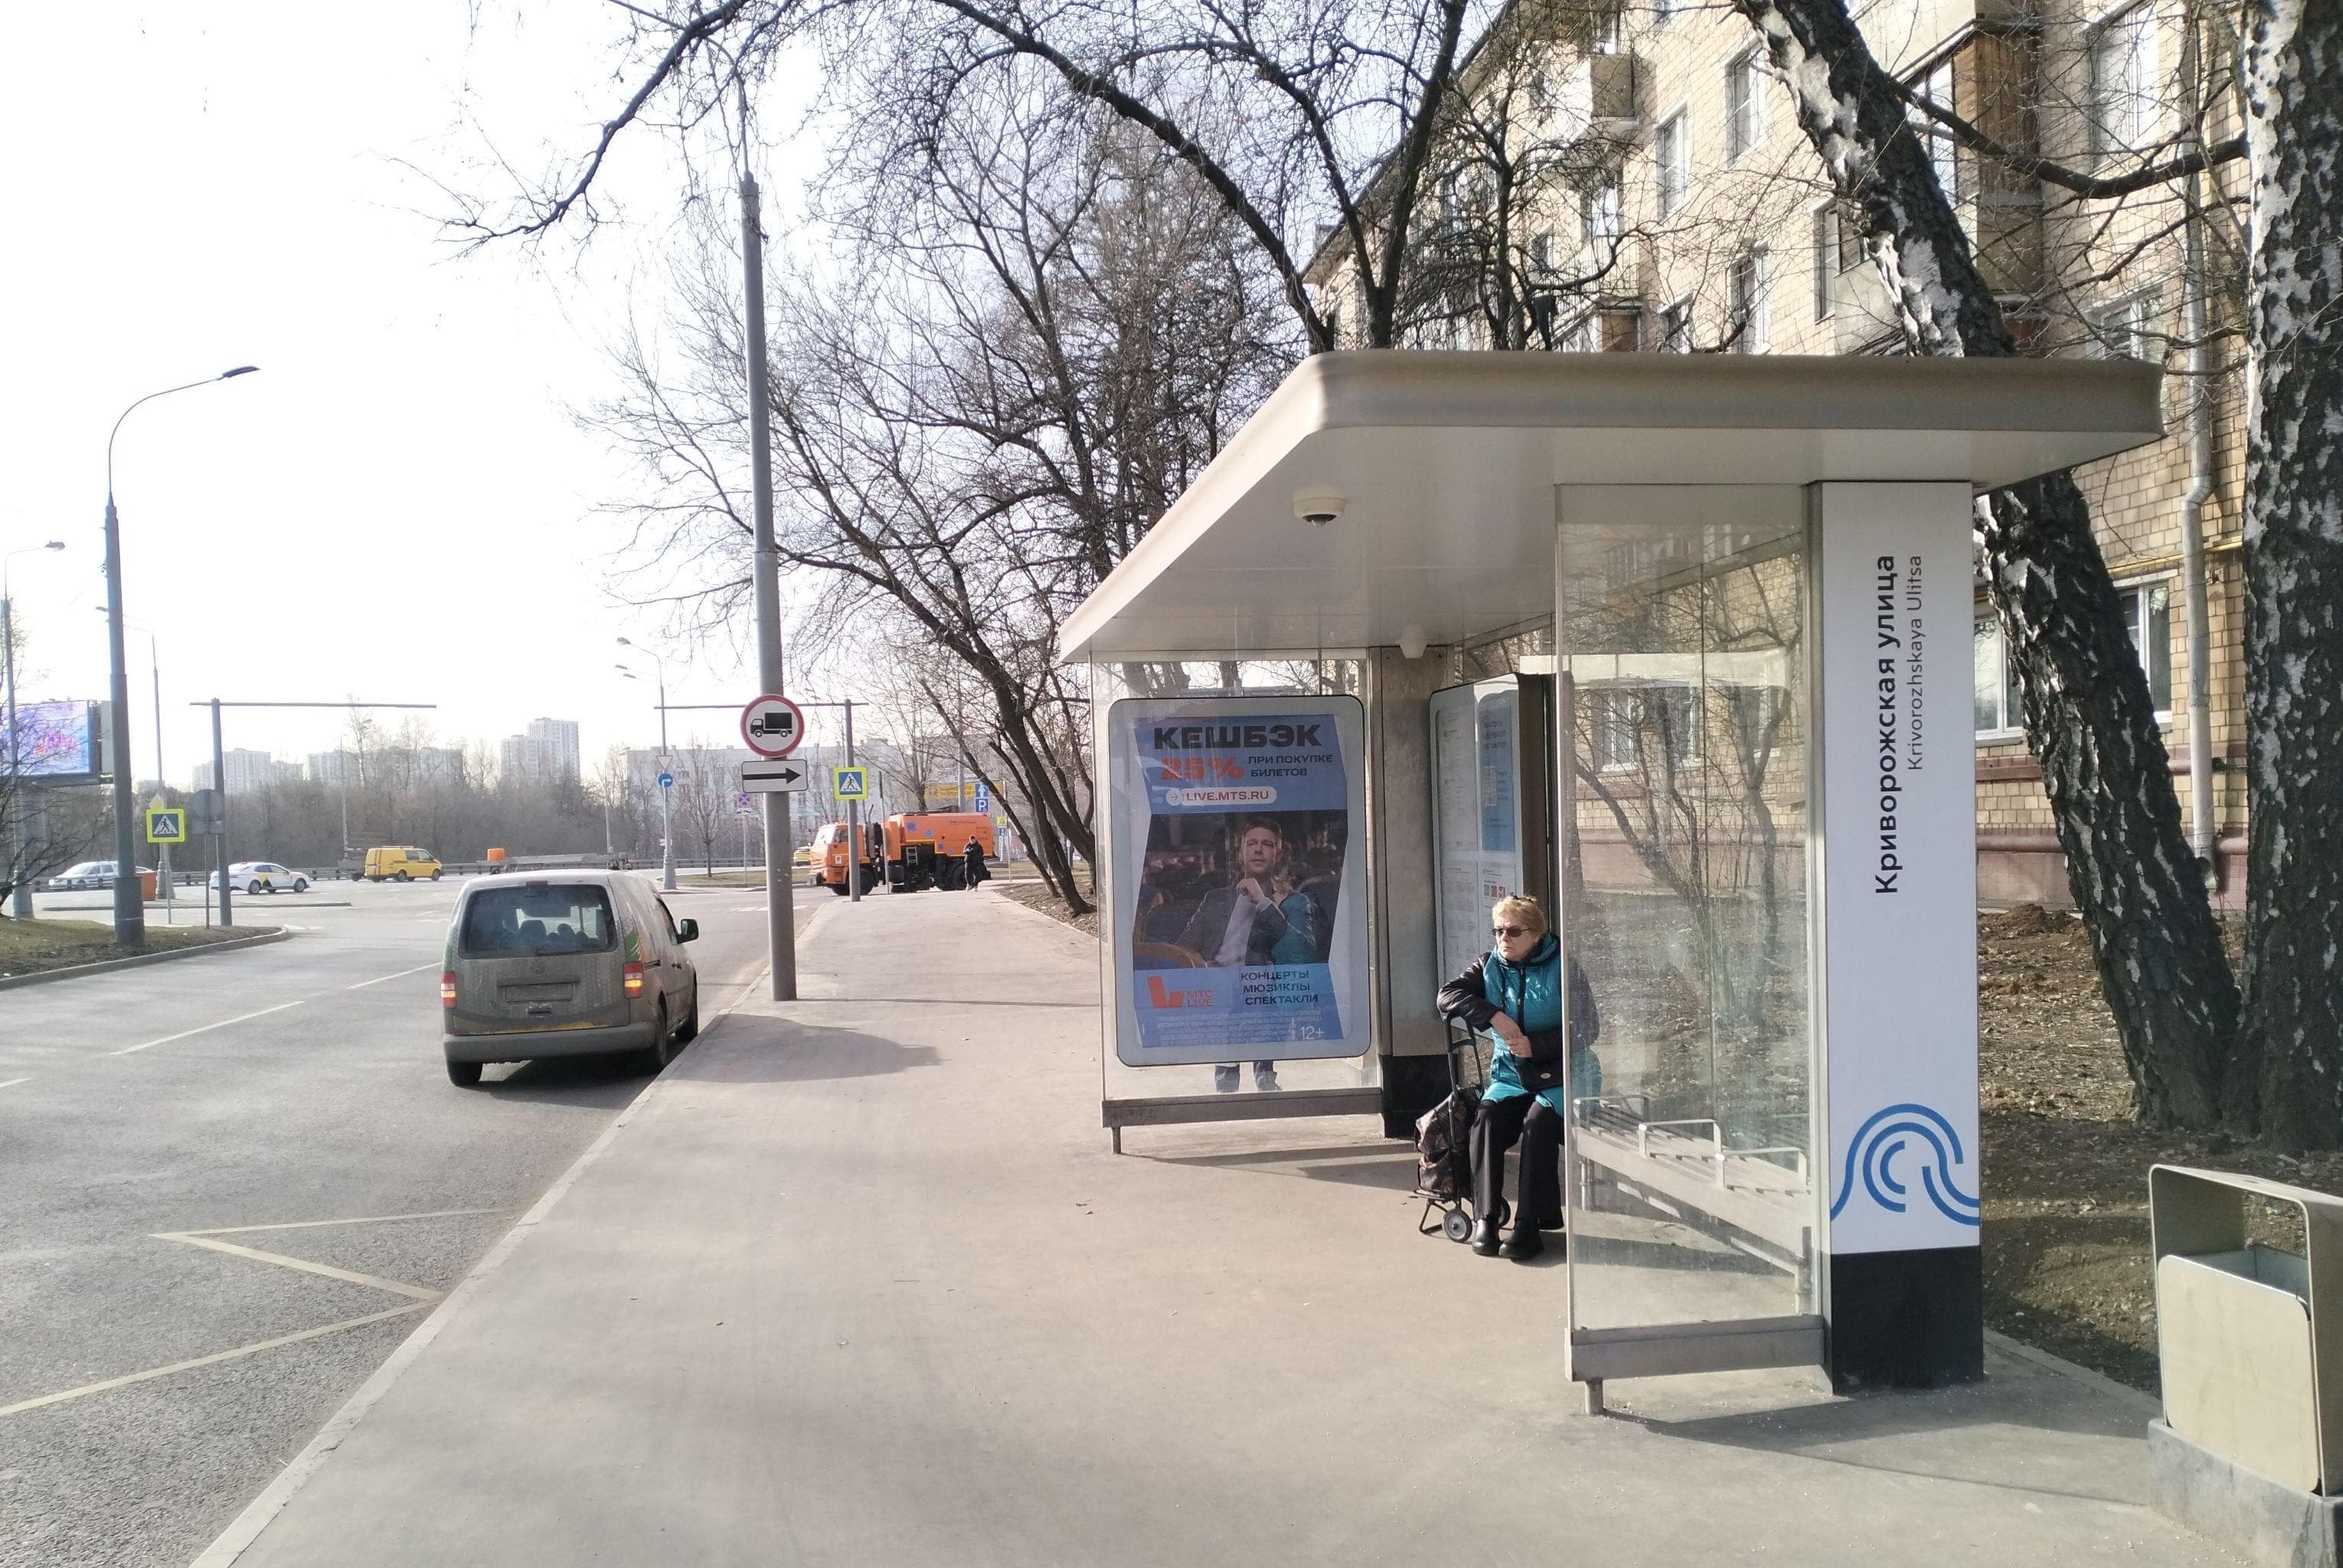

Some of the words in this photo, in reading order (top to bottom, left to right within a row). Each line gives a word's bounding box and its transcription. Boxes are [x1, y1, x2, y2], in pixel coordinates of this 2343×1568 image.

[1906, 556, 1923, 611] Ulitsa
[1877, 556, 1901, 648] улица
[1906, 618, 1926, 770] Krivorozhskaya
[1154, 724, 1323, 750] КЕШБЭК
[1248, 756, 1274, 764] ПРИ
[1276, 754, 1333, 764] ПОКУПКЕ
[1160, 756, 1245, 781] 25%
[1251, 768, 1308, 777] БИЛЕТОВ
[1874, 658, 1903, 893] Криворожская
[1187, 791, 1270, 801] LIVE.MTS.RU
[1240, 970, 1309, 981] КОНЦЕРТЫ
[1243, 983, 1311, 993] МЮЗИКЛЫ
[1245, 995, 1319, 1006] СПЕКТАКЛИ
[1301, 1027, 1325, 1040] 12+
